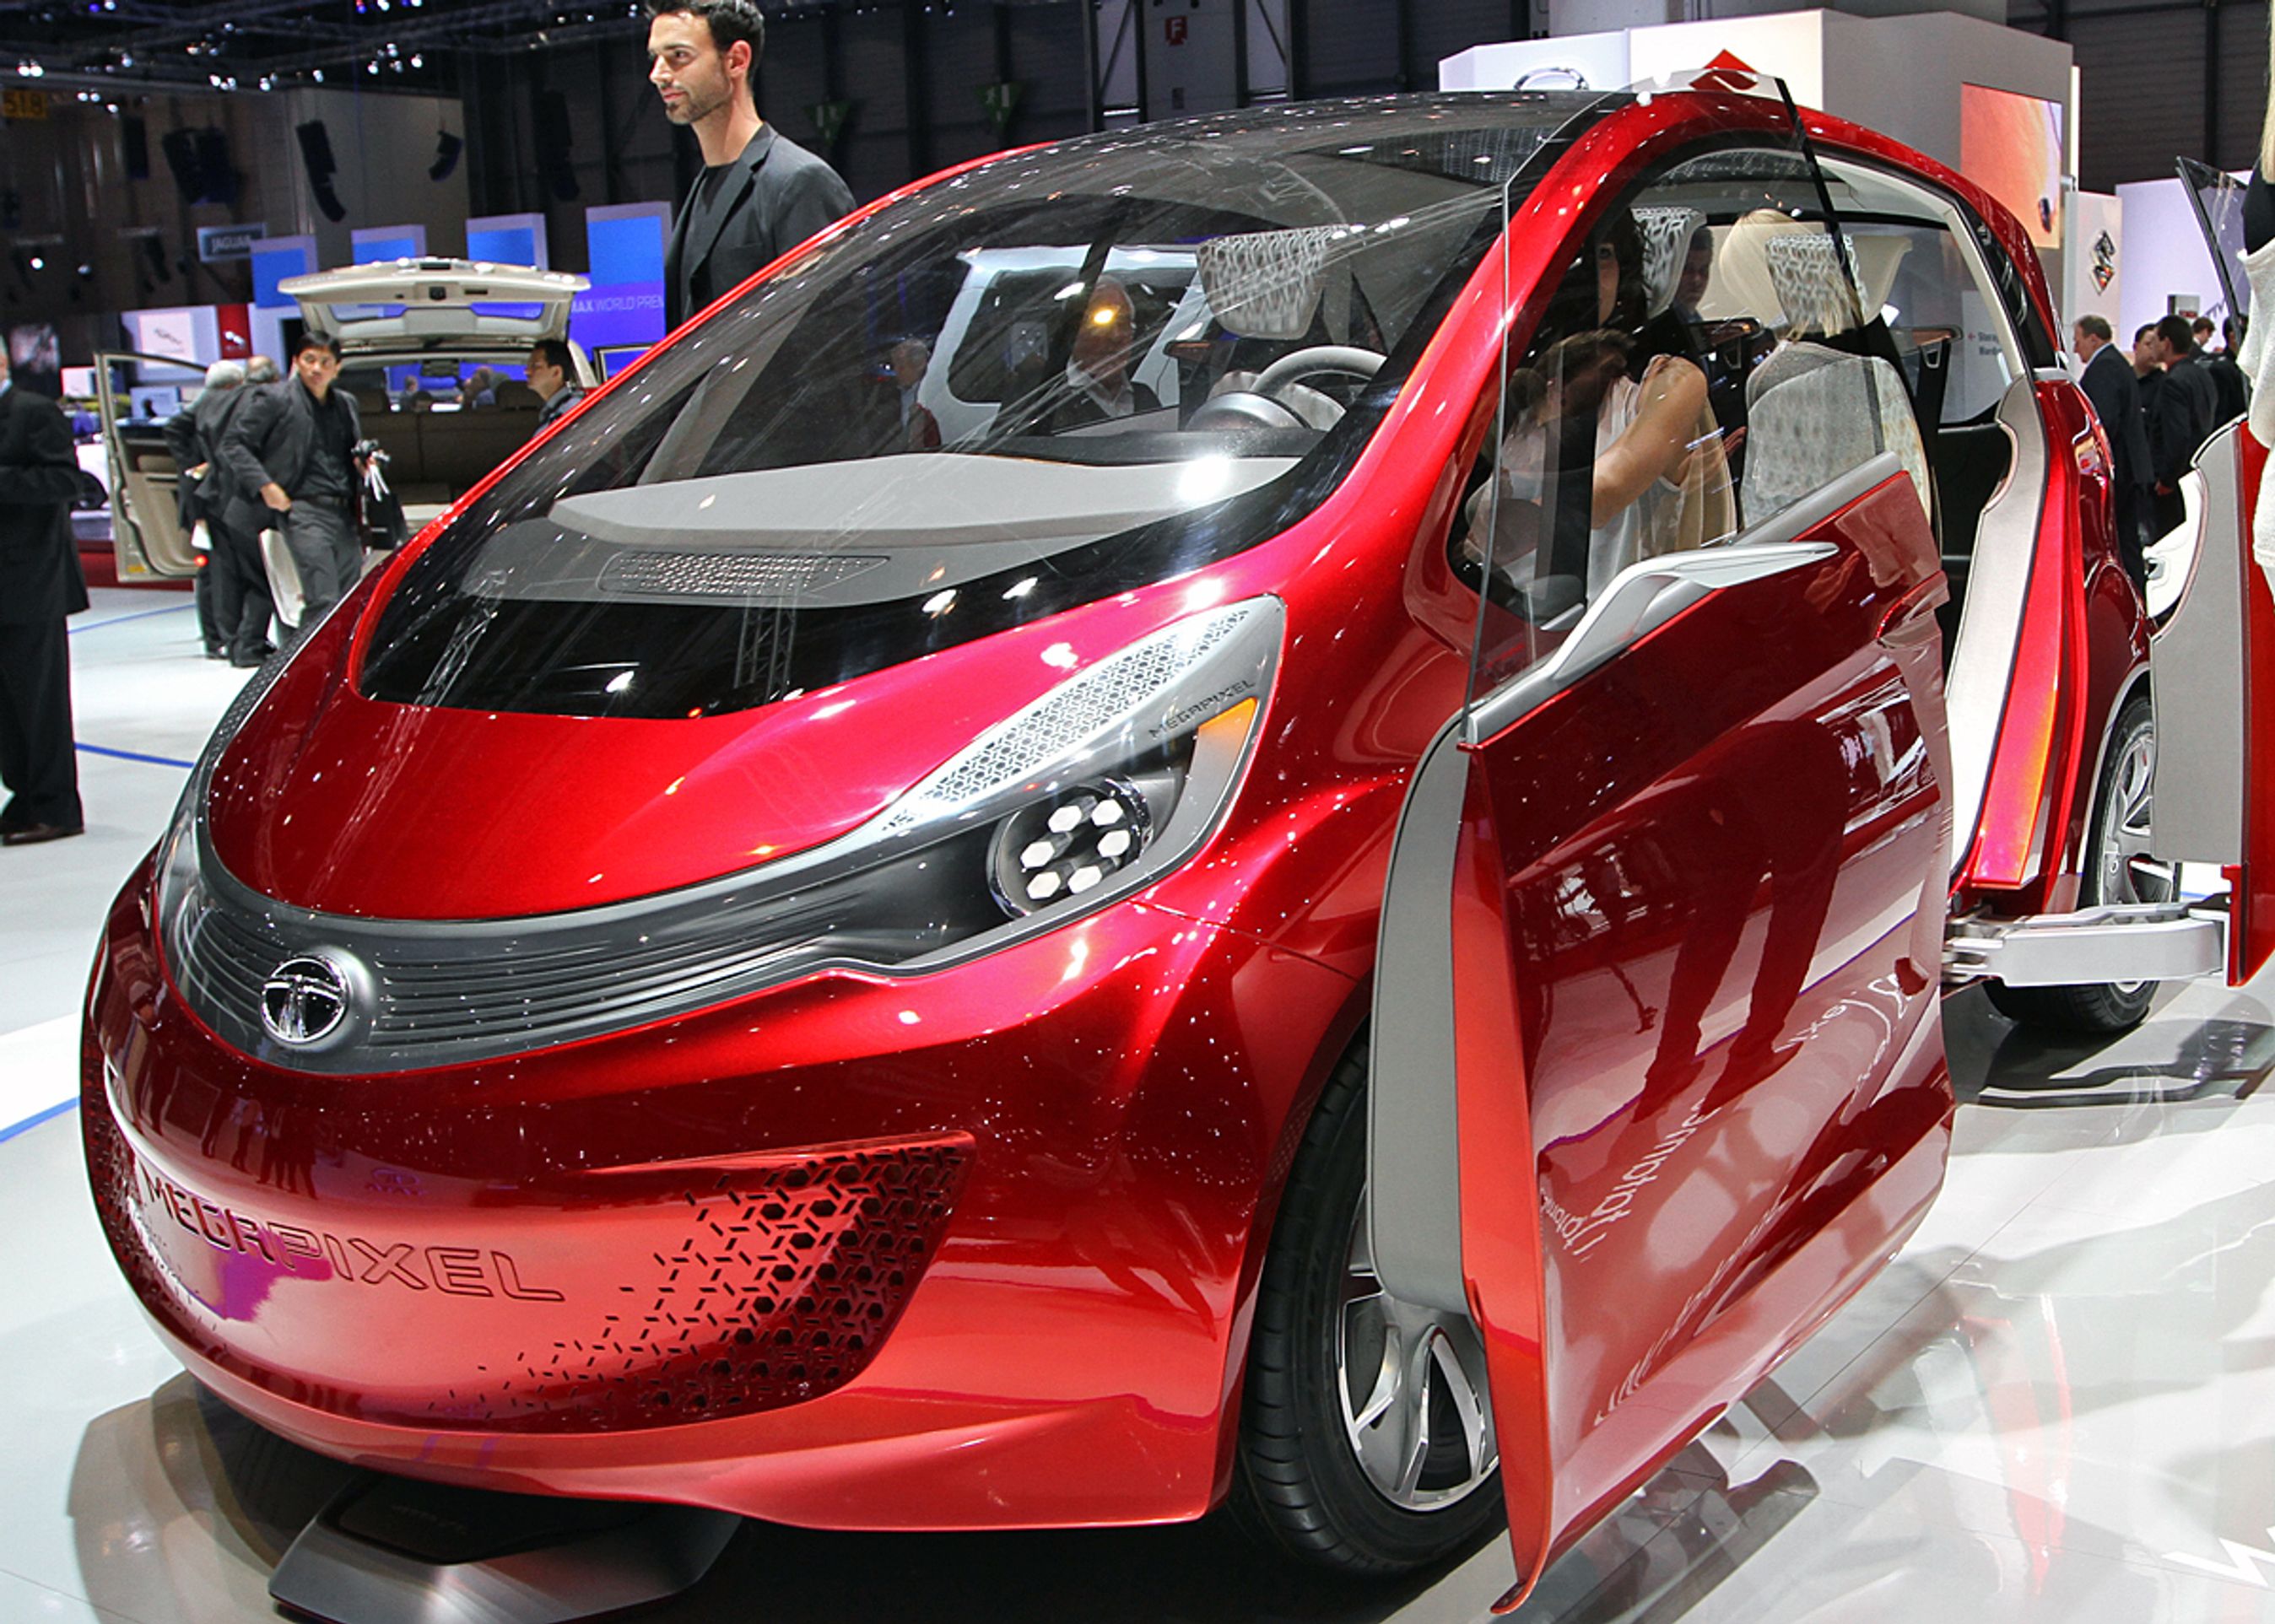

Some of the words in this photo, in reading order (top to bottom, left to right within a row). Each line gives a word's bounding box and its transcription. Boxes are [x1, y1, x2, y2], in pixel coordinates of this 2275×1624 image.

[594, 296, 635, 312] WORLD
[1148, 679, 1256, 738] MEGAPIXEL
[138, 1160, 565, 1302] MEGAPIXEL
